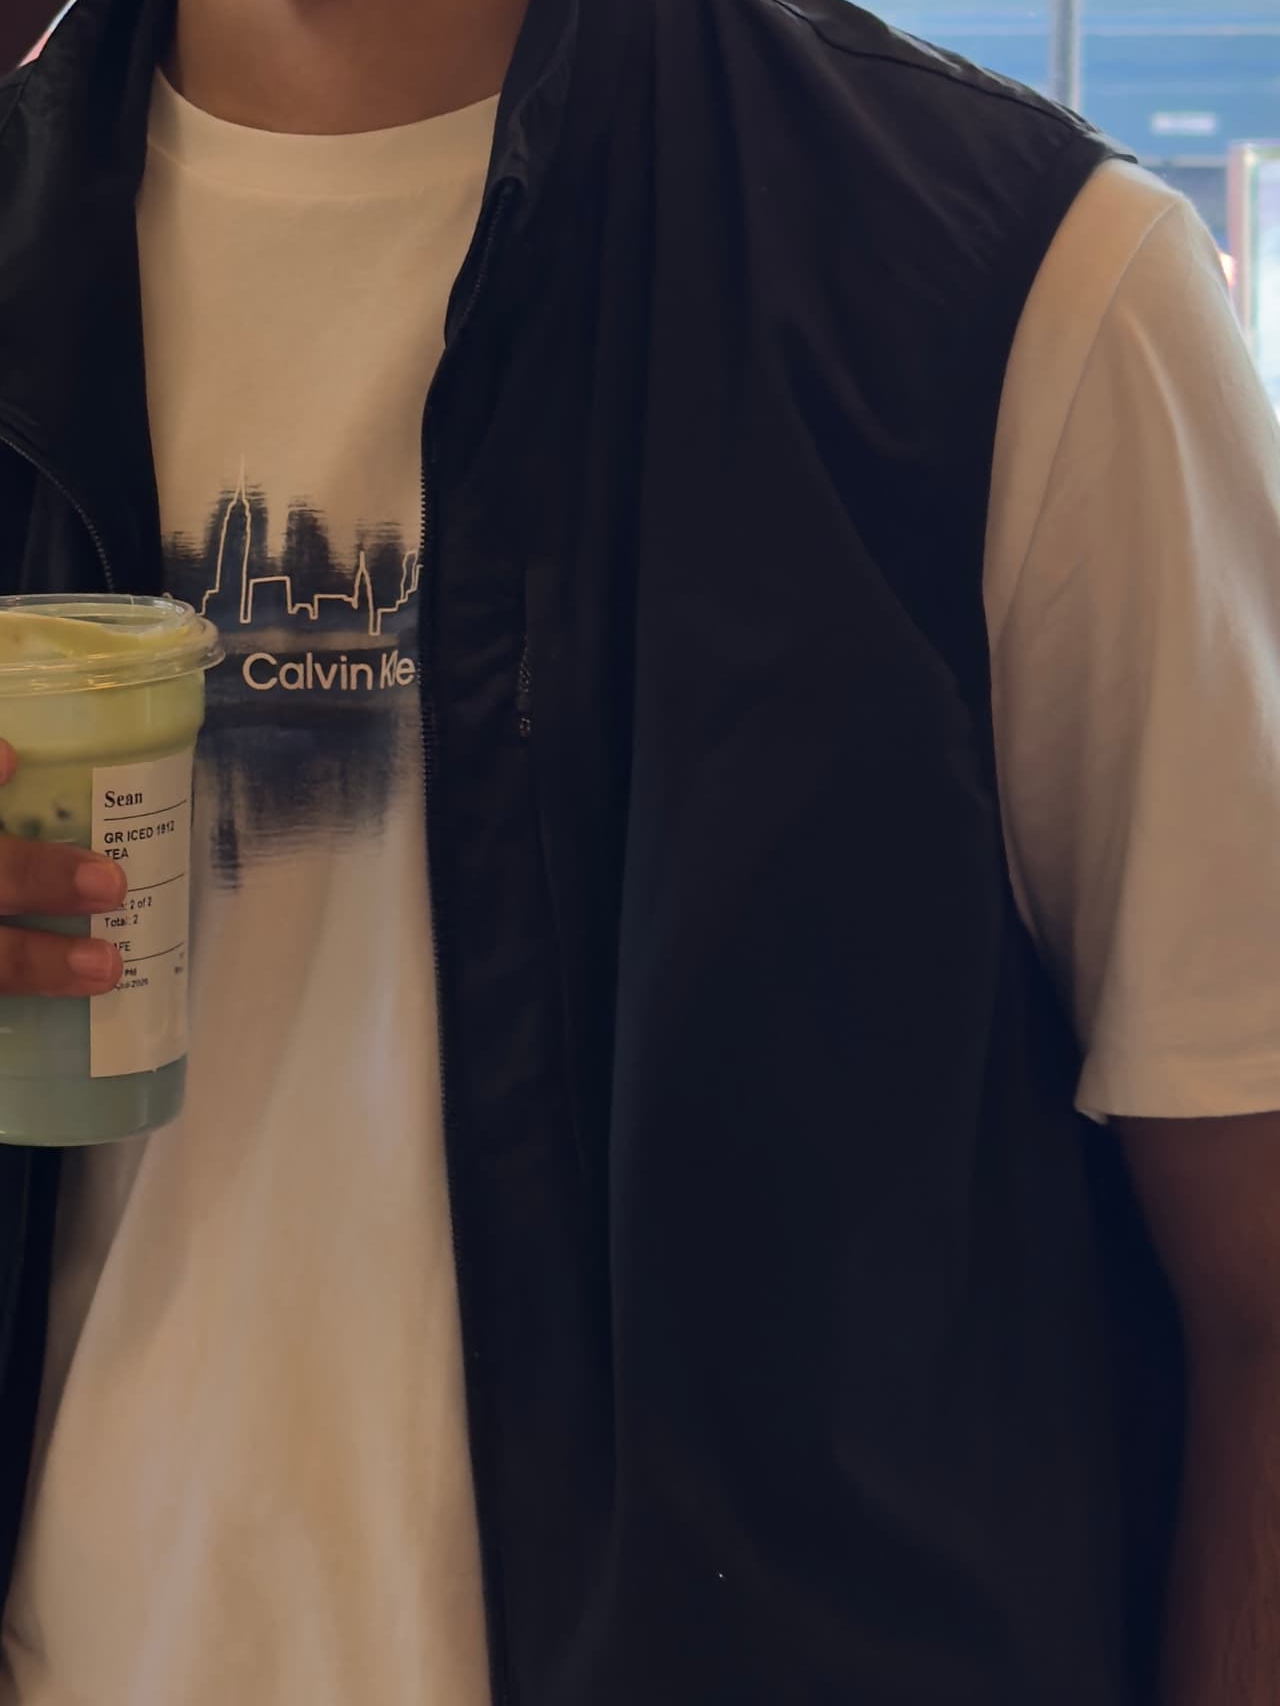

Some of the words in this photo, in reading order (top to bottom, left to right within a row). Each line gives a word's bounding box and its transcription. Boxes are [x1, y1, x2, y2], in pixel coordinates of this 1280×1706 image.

[242, 651, 374, 690] Calvin
[380, 649, 417, 689] Kle
[104, 790, 143, 808] Sean
[104, 831, 124, 844] GR
[127, 826, 154, 842] ICED
[104, 847, 129, 860] TEA
